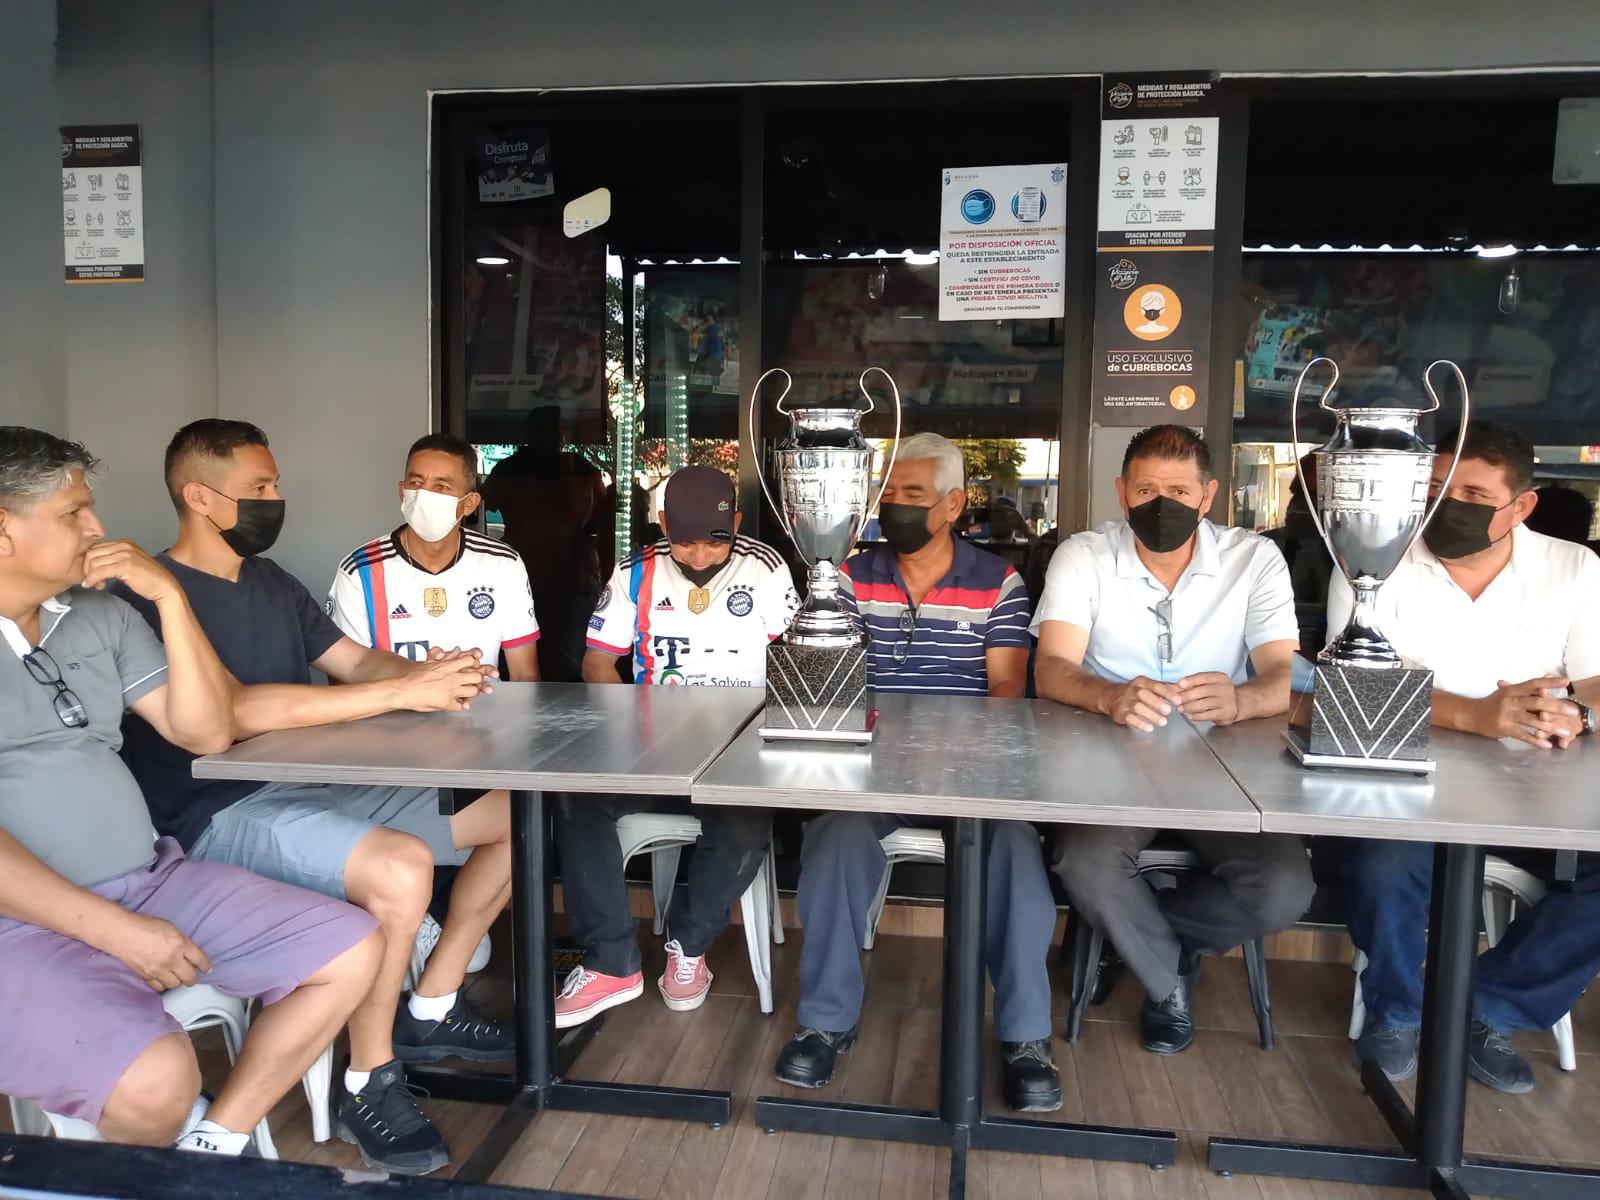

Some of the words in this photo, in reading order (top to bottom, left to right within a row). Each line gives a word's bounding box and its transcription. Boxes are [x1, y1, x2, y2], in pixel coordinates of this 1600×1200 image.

[485, 141, 528, 155] Disfruta
[969, 240, 1022, 249] DISPOSICIÓN
[1108, 354, 1130, 362] USO
[1133, 354, 1192, 362] EXCLUSIVO
[654, 636, 690, 670] T
